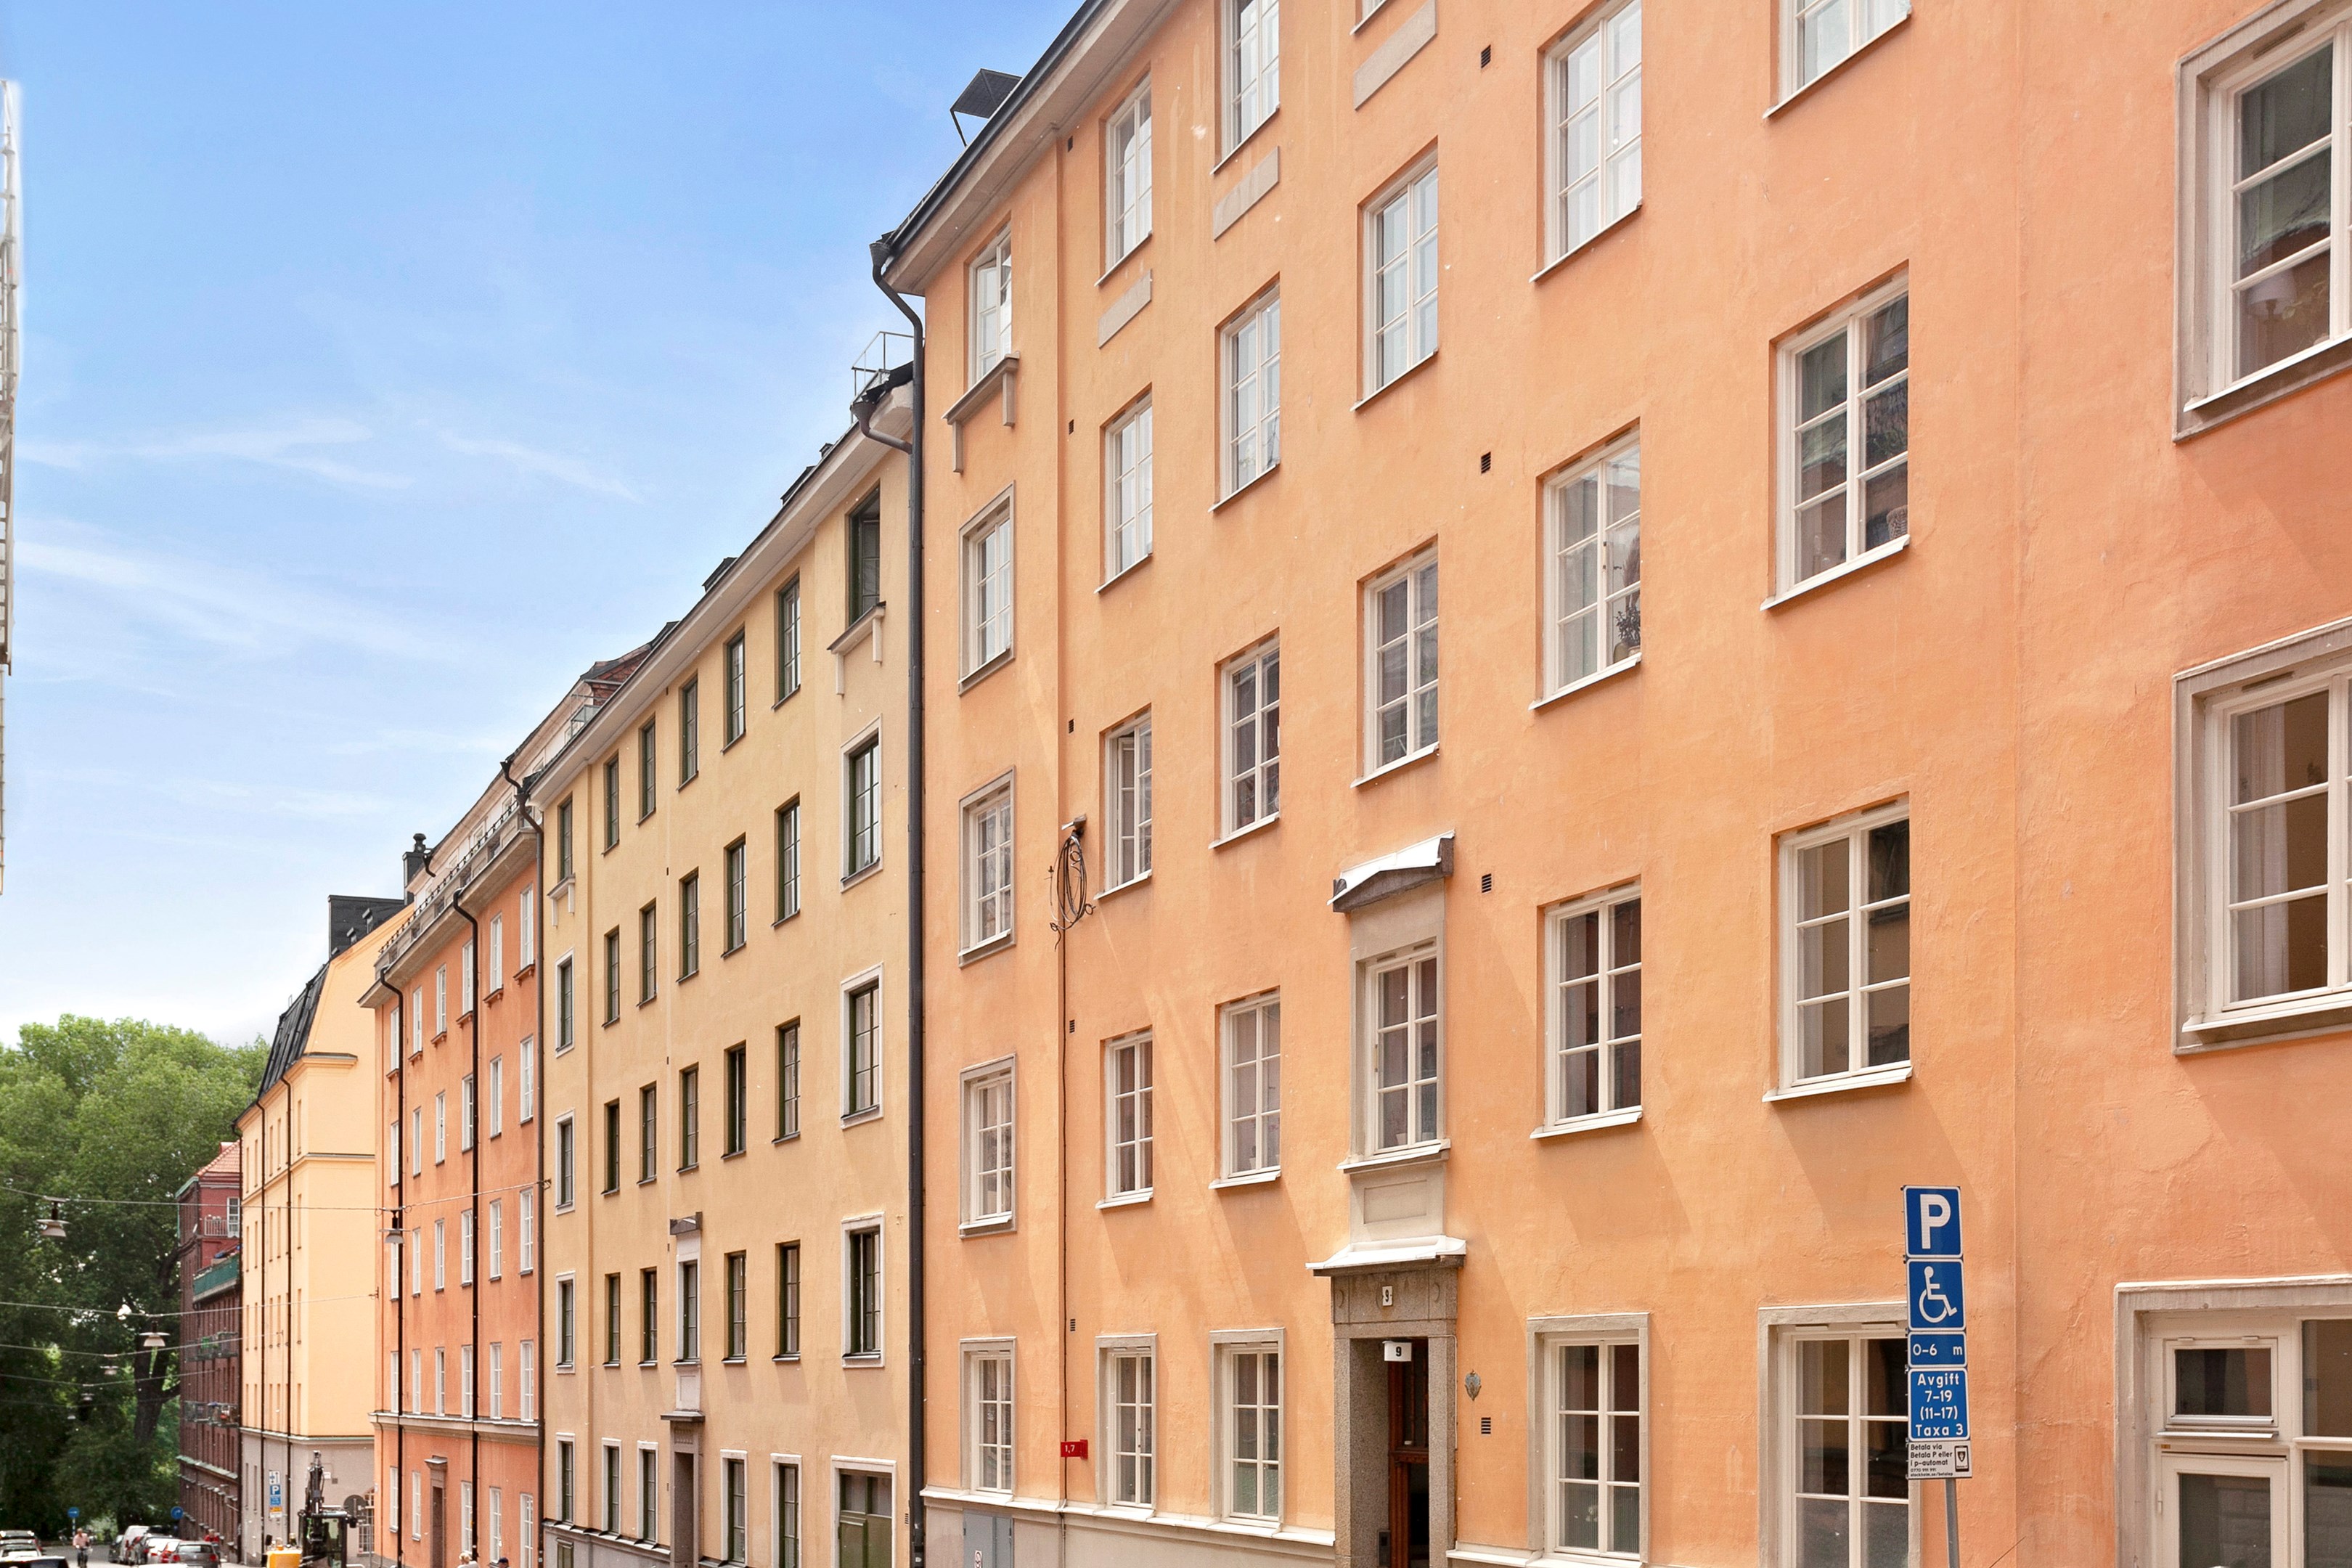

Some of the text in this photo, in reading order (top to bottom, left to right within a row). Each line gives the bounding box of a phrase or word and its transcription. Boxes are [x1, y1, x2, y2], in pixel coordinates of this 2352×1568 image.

[1920, 1193, 1951, 1249] P
[1385, 1289, 1389, 1302] 9
[1395, 1346, 1402, 1357] 9
[1913, 1344, 1963, 1356] 0-6 m
[1917, 1373, 1959, 1388] Avgift
[1924, 1389, 1953, 1402] 7-19
[1920, 1405, 1959, 1420] (11-17)
[1916, 1424, 1964, 1437] Taxa 3
[1065, 1445, 1075, 1453] 1,7
[272, 1485, 279, 1495] P
